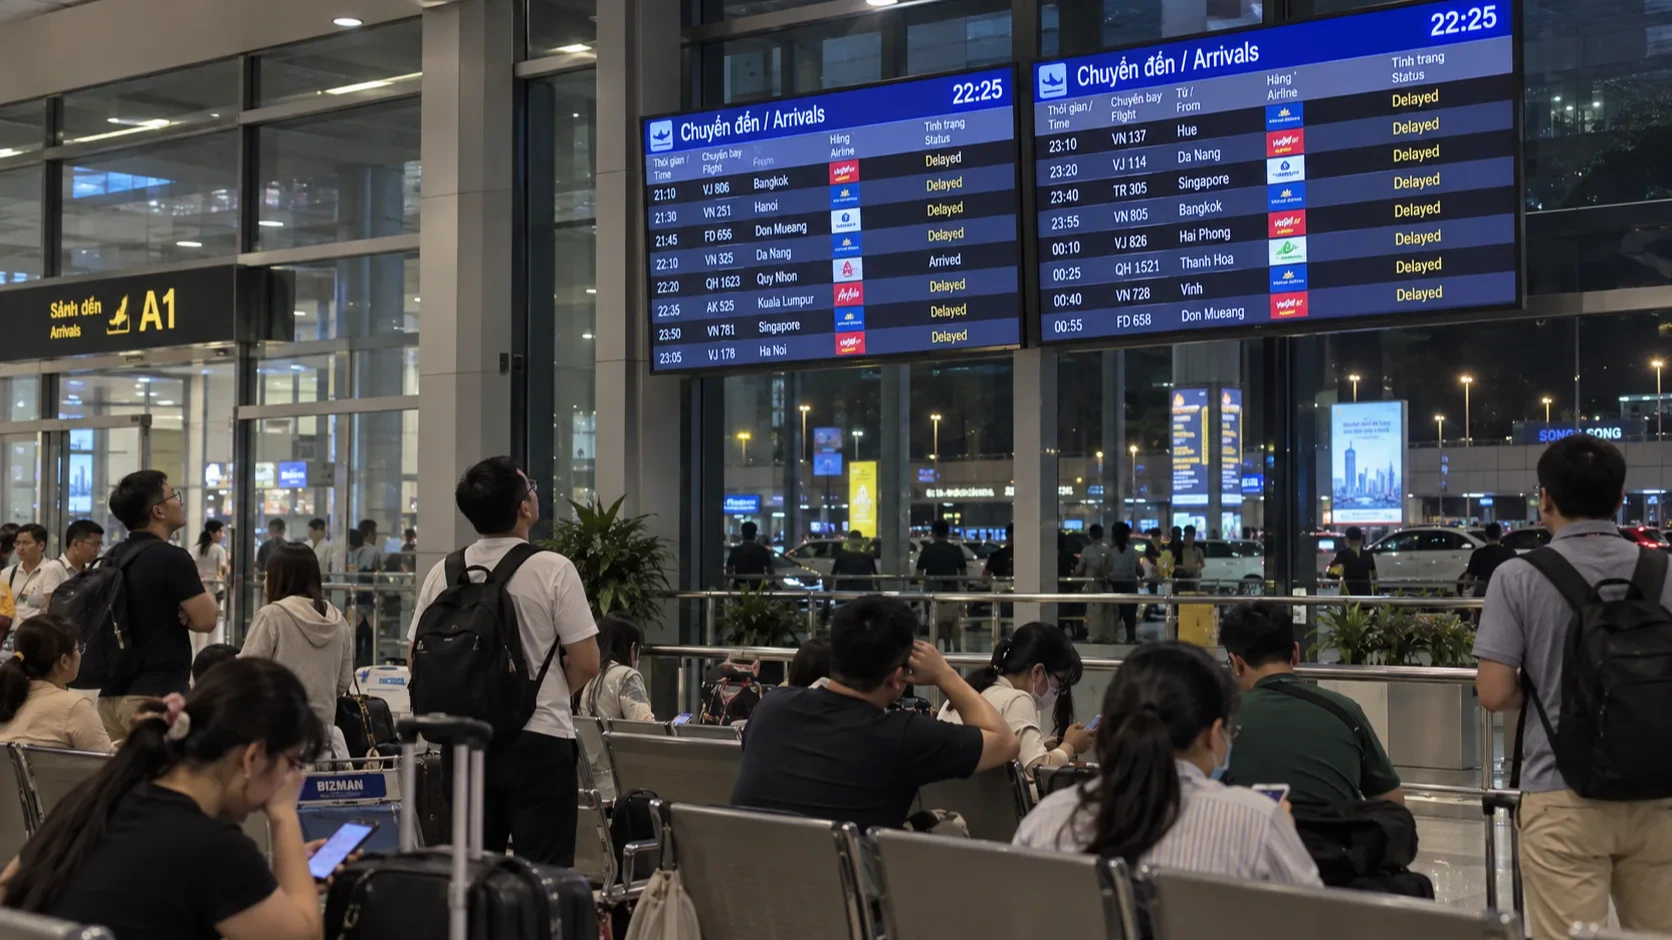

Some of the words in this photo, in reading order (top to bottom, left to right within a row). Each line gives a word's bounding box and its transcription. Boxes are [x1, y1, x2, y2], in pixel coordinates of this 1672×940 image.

[1431, 5, 1496, 36] 22:25
[1181, 50, 1187, 72] /
[1194, 41, 1259, 70] Arrivals
[953, 79, 1002, 104] 22:25
[1049, 119, 1069, 129] Time
[1177, 102, 1200, 112] From
[1392, 72, 1424, 83] Status
[1069, 102, 1087, 115] gian
[1146, 93, 1162, 104] bay
[764, 111, 769, 130] /
[773, 105, 825, 128] Arrivals
[1050, 138, 1076, 152] 23:10
[1112, 132, 1126, 145] VN
[1129, 130, 1146, 143] 137
[1178, 124, 1197, 137] Hue
[1393, 89, 1438, 107] Delayed
[654, 171, 671, 180] Time
[925, 135, 950, 145] Status
[1050, 164, 1077, 178] 23:20
[1113, 158, 1125, 170] VJ
[1129, 156, 1146, 169] 114
[1178, 151, 1191, 163] Da
[1195, 149, 1220, 161] Nang
[1393, 117, 1439, 135] Delayed
[654, 188, 675, 200] 21:10
[703, 184, 712, 195] VJ
[715, 182, 729, 194] 806
[754, 175, 788, 190] Bangkok
[926, 151, 961, 167] Delayed
[1051, 189, 1078, 203] 23:40
[1113, 184, 1126, 197] TR
[1130, 182, 1147, 195] 305
[1179, 175, 1229, 190] Singapore
[1394, 144, 1439, 162] Delayed
[656, 211, 676, 224] 21:30
[703, 207, 715, 218] VN
[717, 205, 731, 217] 251
[755, 199, 778, 212] Hanoi
[927, 176, 962, 191] Delayed
[1052, 215, 1079, 230] 23:55
[1114, 210, 1128, 222] VN
[1130, 208, 1148, 221] 805
[1180, 200, 1222, 216] Bangkok
[1394, 172, 1439, 189] Delayed
[656, 234, 677, 247] 21:45
[705, 230, 715, 241] FD
[717, 229, 732, 240] 656
[756, 225, 772, 236] Don
[774, 223, 807, 234] Mueang
[928, 201, 963, 217] Delayed
[1053, 241, 1080, 255] 00:10
[1115, 237, 1126, 249] VJ
[1130, 235, 1147, 248] 826
[1180, 229, 1195, 242] Hai
[1199, 228, 1230, 240] Phong
[1395, 201, 1440, 218] Delayed
[657, 258, 678, 270] 22:10
[705, 254, 716, 265] VN
[719, 252, 733, 264] 325
[757, 249, 767, 260] Da
[770, 248, 791, 260] Nang
[928, 227, 964, 241] Delayed
[1053, 267, 1080, 281] 00:25
[1116, 262, 1131, 276] QH
[1135, 260, 1159, 273] 1521
[1180, 255, 1211, 269] Thanh
[1214, 254, 1233, 265] Hoa
[1396, 229, 1441, 246] Delayed
[657, 281, 679, 293] 22:20
[706, 278, 718, 290] QH
[721, 276, 740, 288] 1623
[757, 273, 773, 286] Quy
[776, 271, 797, 282] Nhon
[929, 253, 961, 267] Arrived
[1054, 293, 1081, 307] 00:40
[1116, 289, 1130, 301] VN
[1133, 287, 1150, 300] 728
[1181, 282, 1202, 295] Vinh
[1397, 257, 1441, 274] Delayed
[139, 288, 174, 331] A1
[658, 304, 680, 317] 22:35
[707, 301, 718, 312] AK
[720, 300, 734, 312] 525
[758, 296, 780, 308] Kuala
[783, 296, 814, 307] Lumpur
[930, 278, 965, 293] Delayed
[1055, 319, 1082, 333] 00:55
[1117, 315, 1130, 328] FD
[1133, 313, 1151, 326] 658
[1182, 310, 1201, 322] Don
[1205, 307, 1244, 320] Mueang
[1397, 285, 1442, 302] Delayed
[50, 324, 81, 339] Arrivals
[659, 328, 681, 340] 23:50
[707, 326, 719, 336] VN
[720, 324, 735, 336] 781
[759, 321, 800, 334] Singapore
[931, 303, 966, 318] Delayed
[660, 352, 681, 364] 23:05
[708, 349, 718, 360] VJ
[721, 348, 735, 359] 178
[760, 346, 771, 356] Ha
[773, 344, 786, 355] Noi
[932, 329, 967, 344] Delayed
[317, 780, 363, 791] BIZMAN
